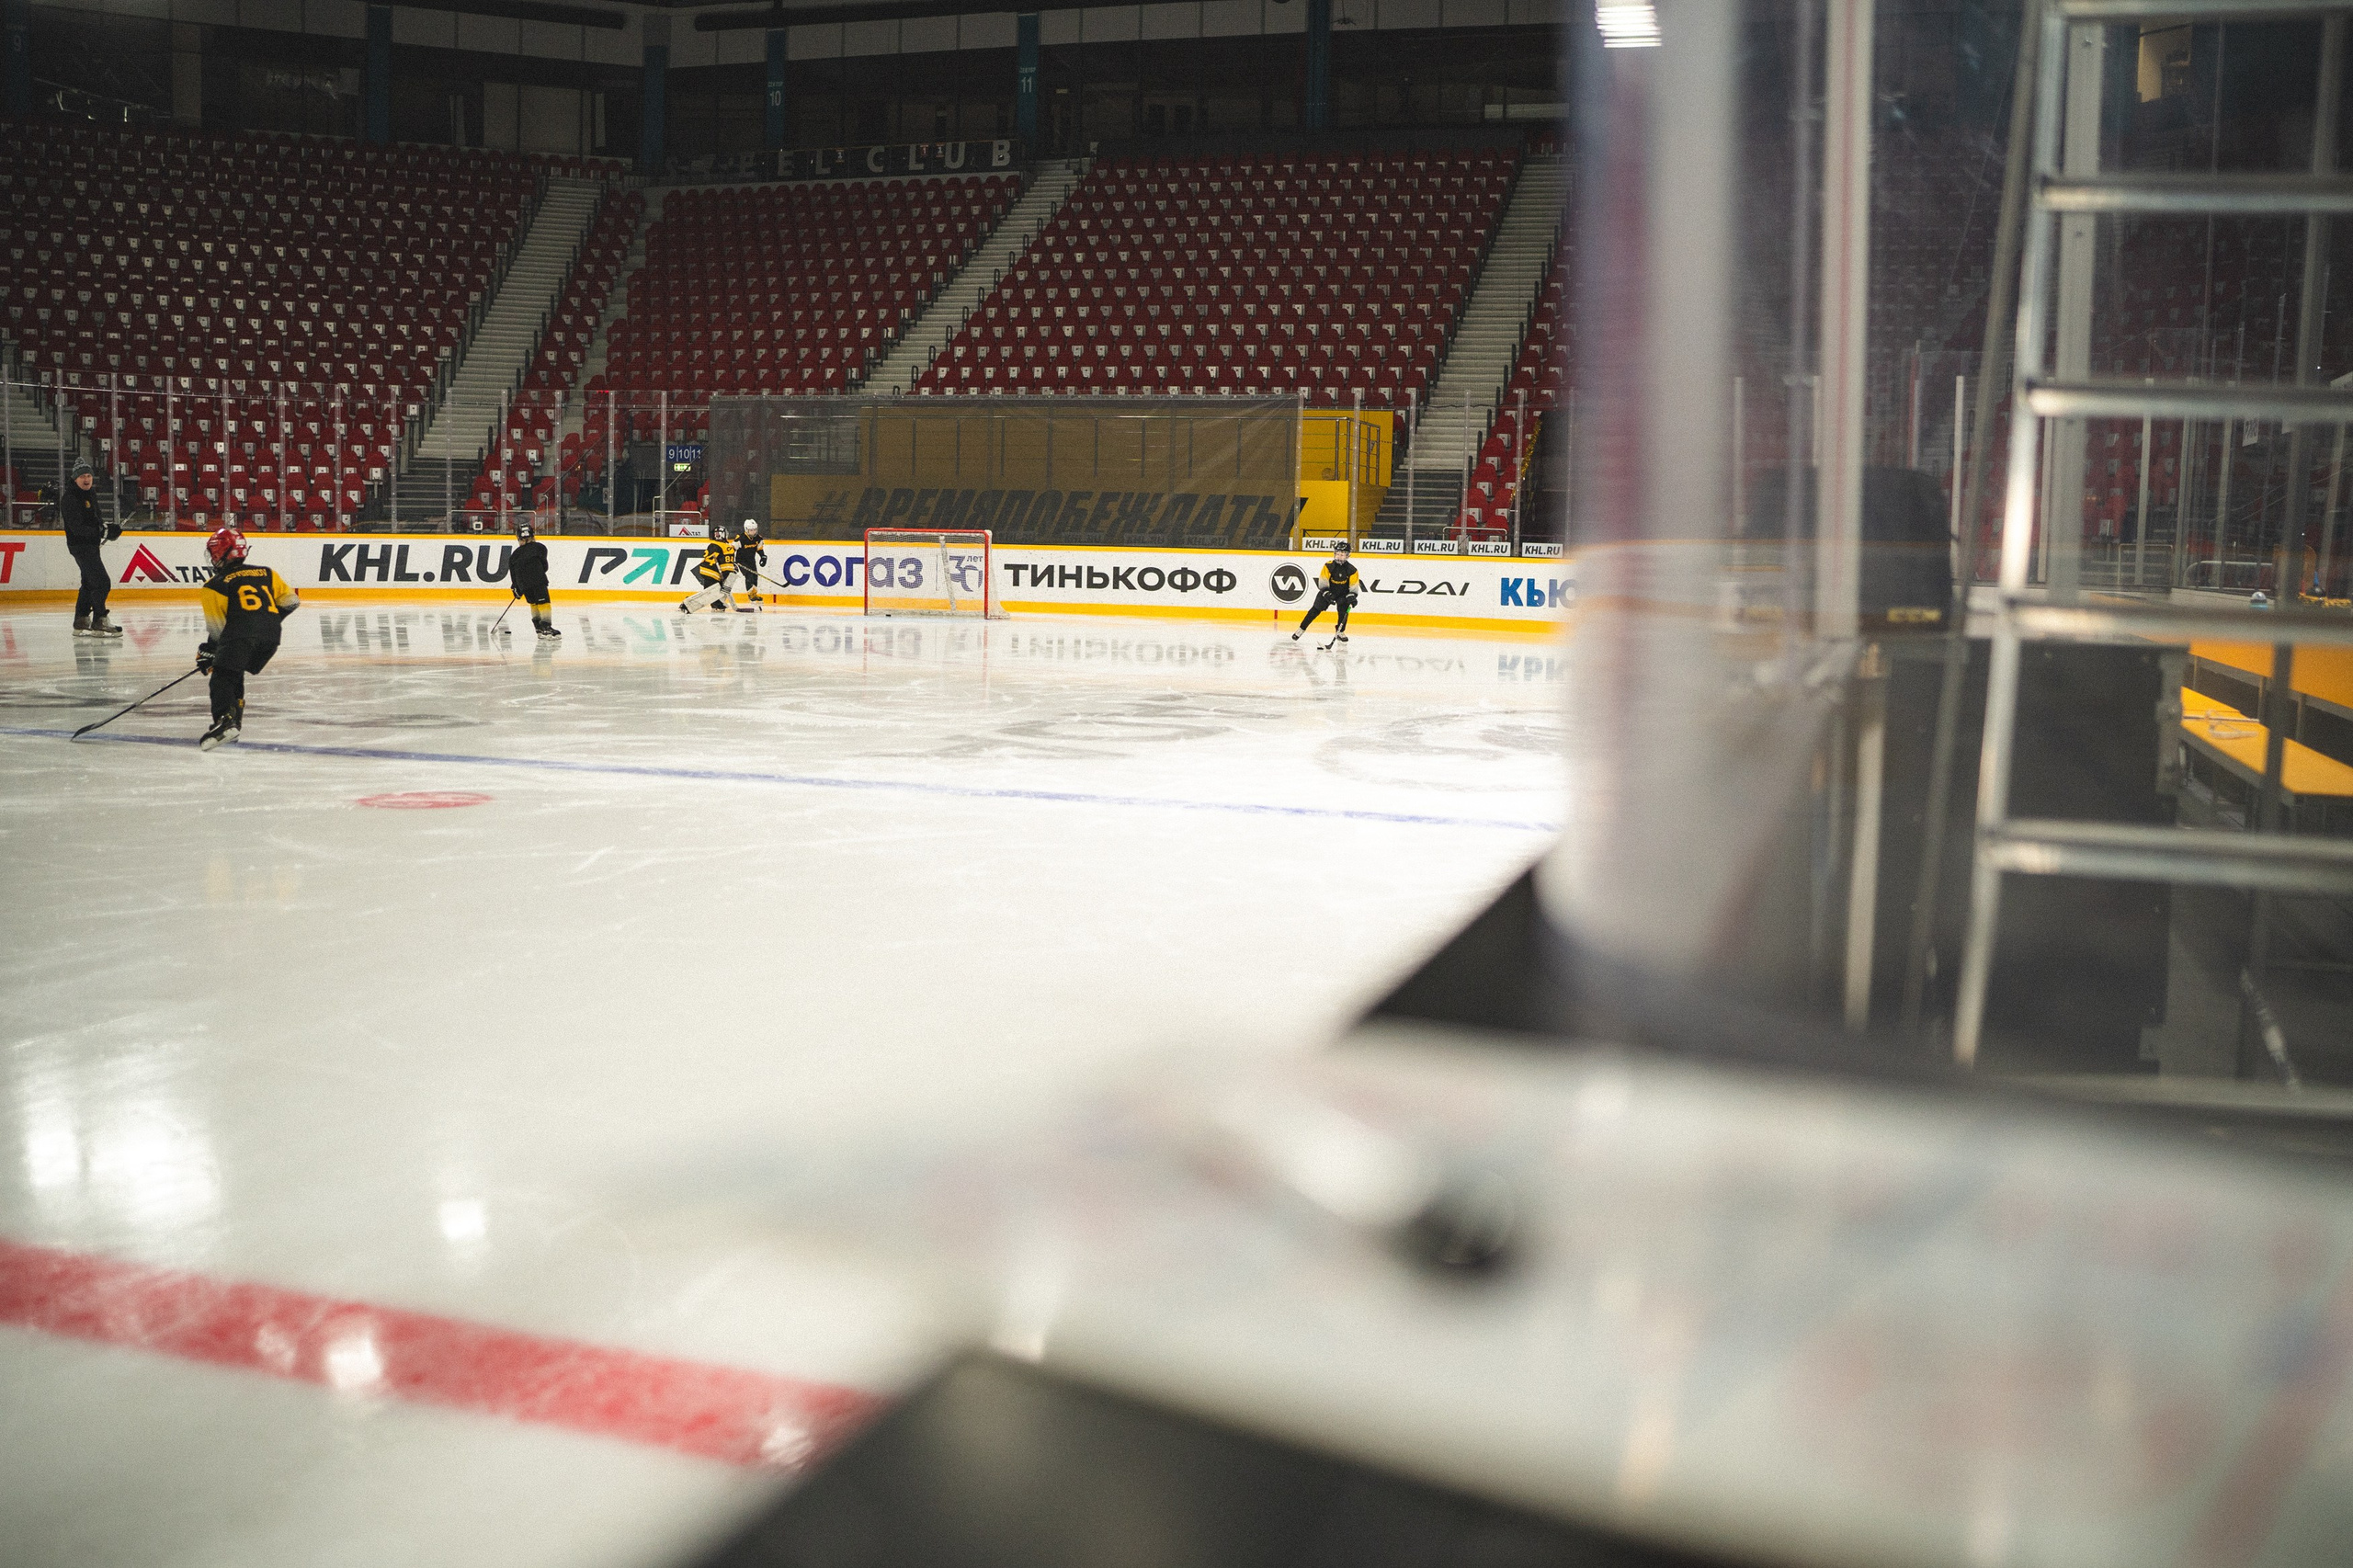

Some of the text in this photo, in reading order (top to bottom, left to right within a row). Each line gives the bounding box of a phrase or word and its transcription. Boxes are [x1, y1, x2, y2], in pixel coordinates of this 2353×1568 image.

[1021, 76, 1033, 94] 11
[769, 90, 781, 108] 10
[866, 139, 1011, 175] CLUB
[668, 449, 676, 460] 9
[678, 449, 690, 460] 10
[1362, 541, 1401, 551] KHL.RU
[1417, 542, 1455, 552] KHL.RU
[1472, 544, 1508, 554] KHL.RU
[1525, 545, 1561, 555] KHL.RU
[319, 543, 512, 583] KHL.RU
[1004, 562, 1237, 595] ТИНЬКОФФ
[237, 585, 279, 614] 61
